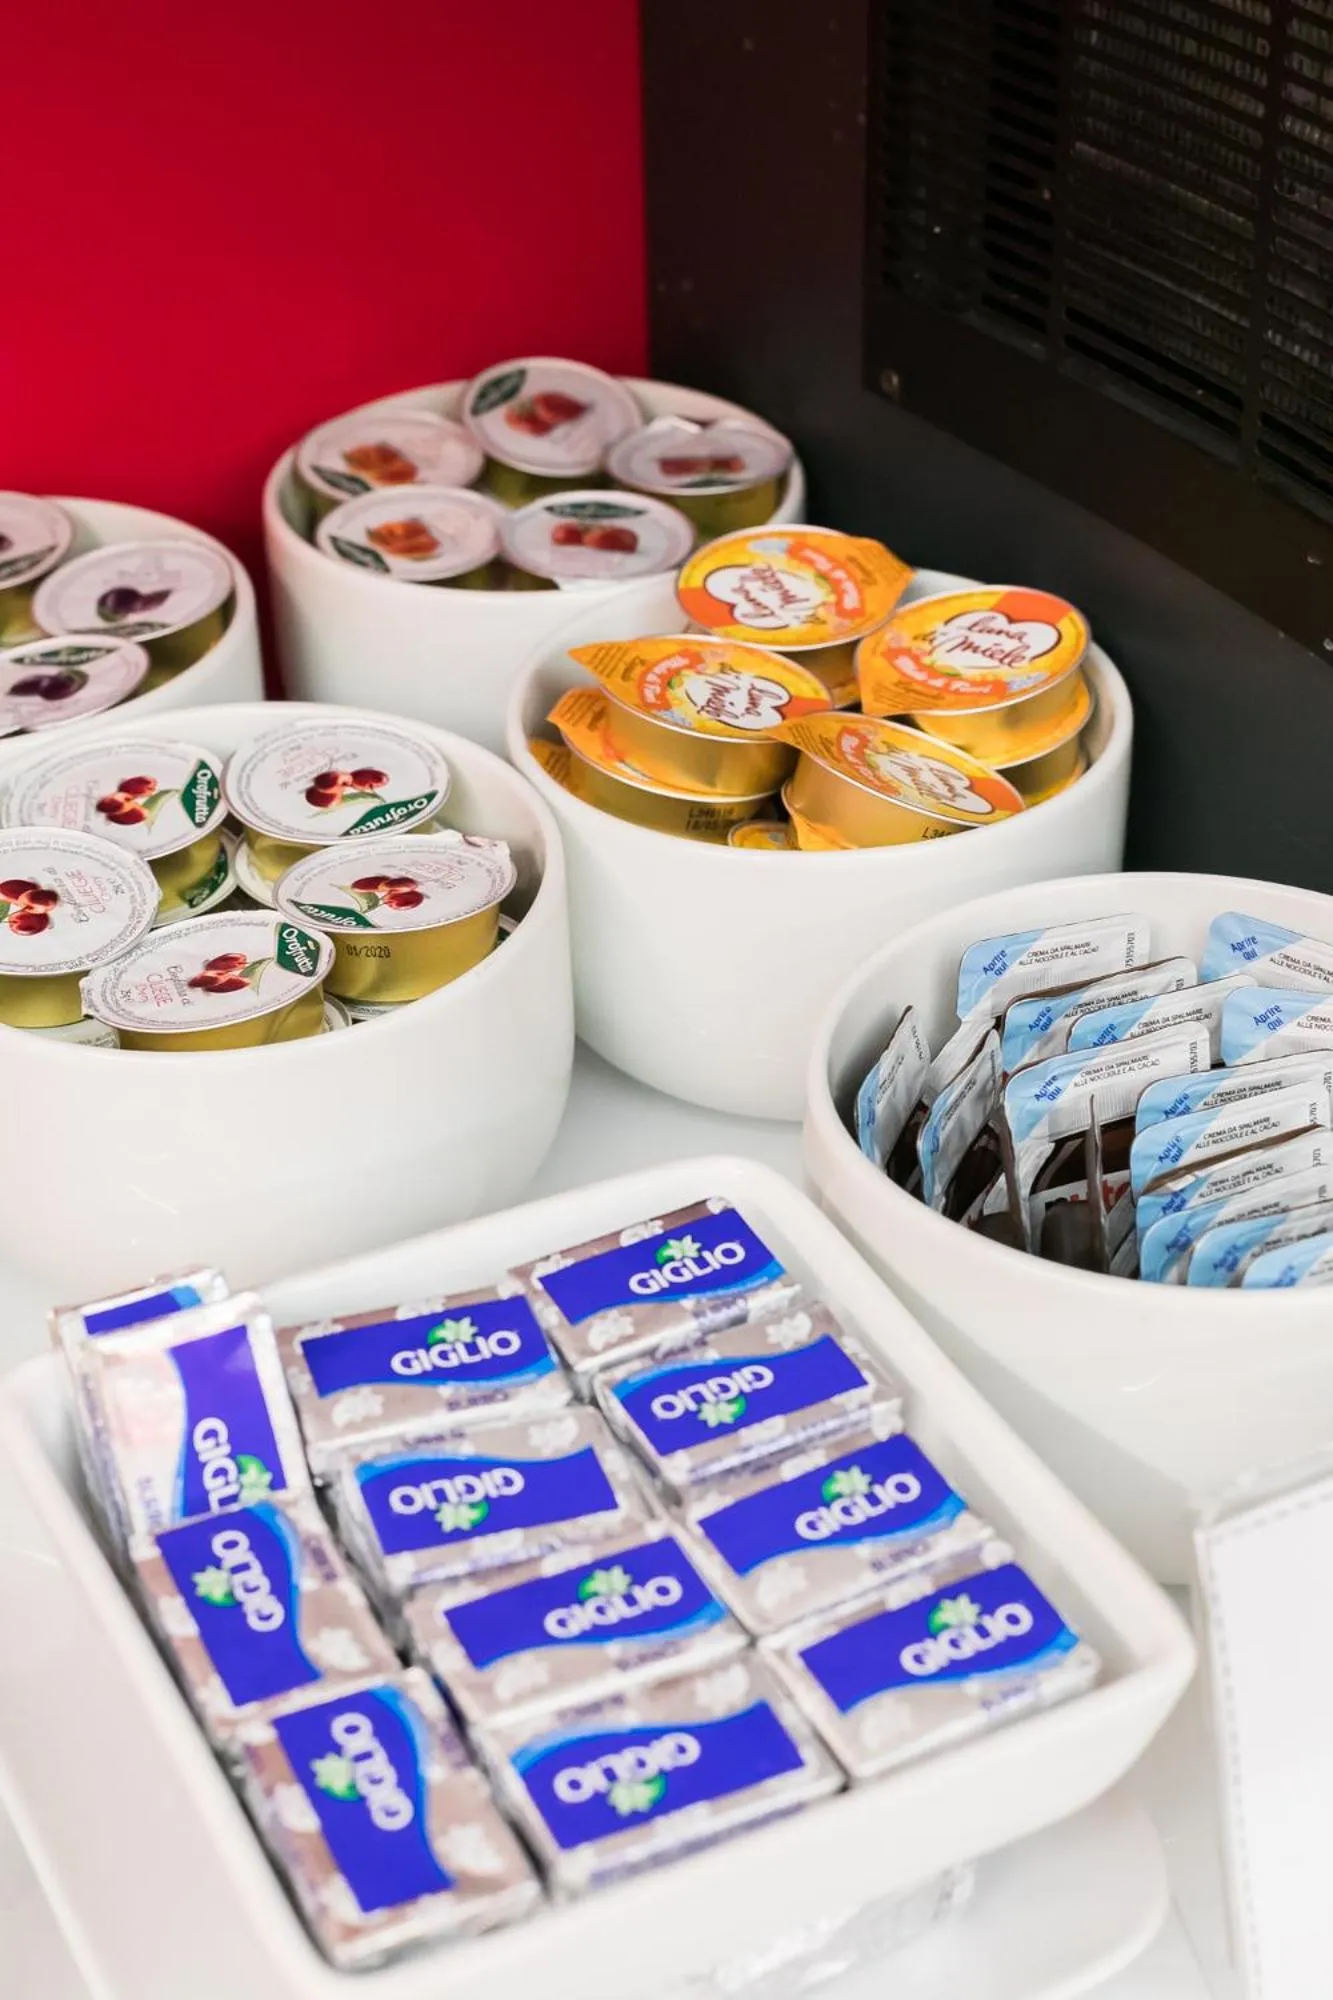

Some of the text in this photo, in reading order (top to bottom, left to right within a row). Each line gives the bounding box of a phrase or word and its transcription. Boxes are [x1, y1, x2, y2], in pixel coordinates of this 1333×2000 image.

[349, 797, 428, 835] Orofrutta
[282, 927, 314, 974] Orofrutta
[1027, 949, 1049, 958] CREMA
[1050, 946, 1059, 954] DA
[1231, 936, 1258, 952] Aprire
[1242, 948, 1257, 961] qui
[982, 950, 1007, 975] Aprire
[994, 961, 1009, 977] qui
[1279, 952, 1300, 965] CREMA
[1302, 960, 1311, 968] DA
[1028, 1006, 1052, 1032] Aprire
[1040, 1017, 1054, 1032] qui
[1253, 1005, 1282, 1026] Aprire
[1267, 1017, 1284, 1031] qui
[1034, 1075, 1058, 1101] Aprire
[1047, 1086, 1062, 1101] qui
[1195, 1141, 1211, 1149] ALLE
[1203, 1129, 1226, 1140] CREMA
[1228, 1125, 1237, 1133] DA
[1158, 1136, 1182, 1163] Aprire
[1170, 1148, 1184, 1163] qui
[629, 1242, 745, 1295] GIGLIO
[390, 1330, 521, 1376] GIGLIO
[651, 1364, 775, 1419] GIGLIO
[389, 1467, 525, 1515] GIGLIO
[795, 1472, 921, 1540] GIGLIO
[211, 1529, 284, 1632] GIGLIO
[544, 1576, 683, 1638] GIGLIO
[900, 1603, 1034, 1676] GIGLIO
[331, 1711, 414, 1831] GIGLIO
[553, 1732, 701, 1803] GIGLIO
